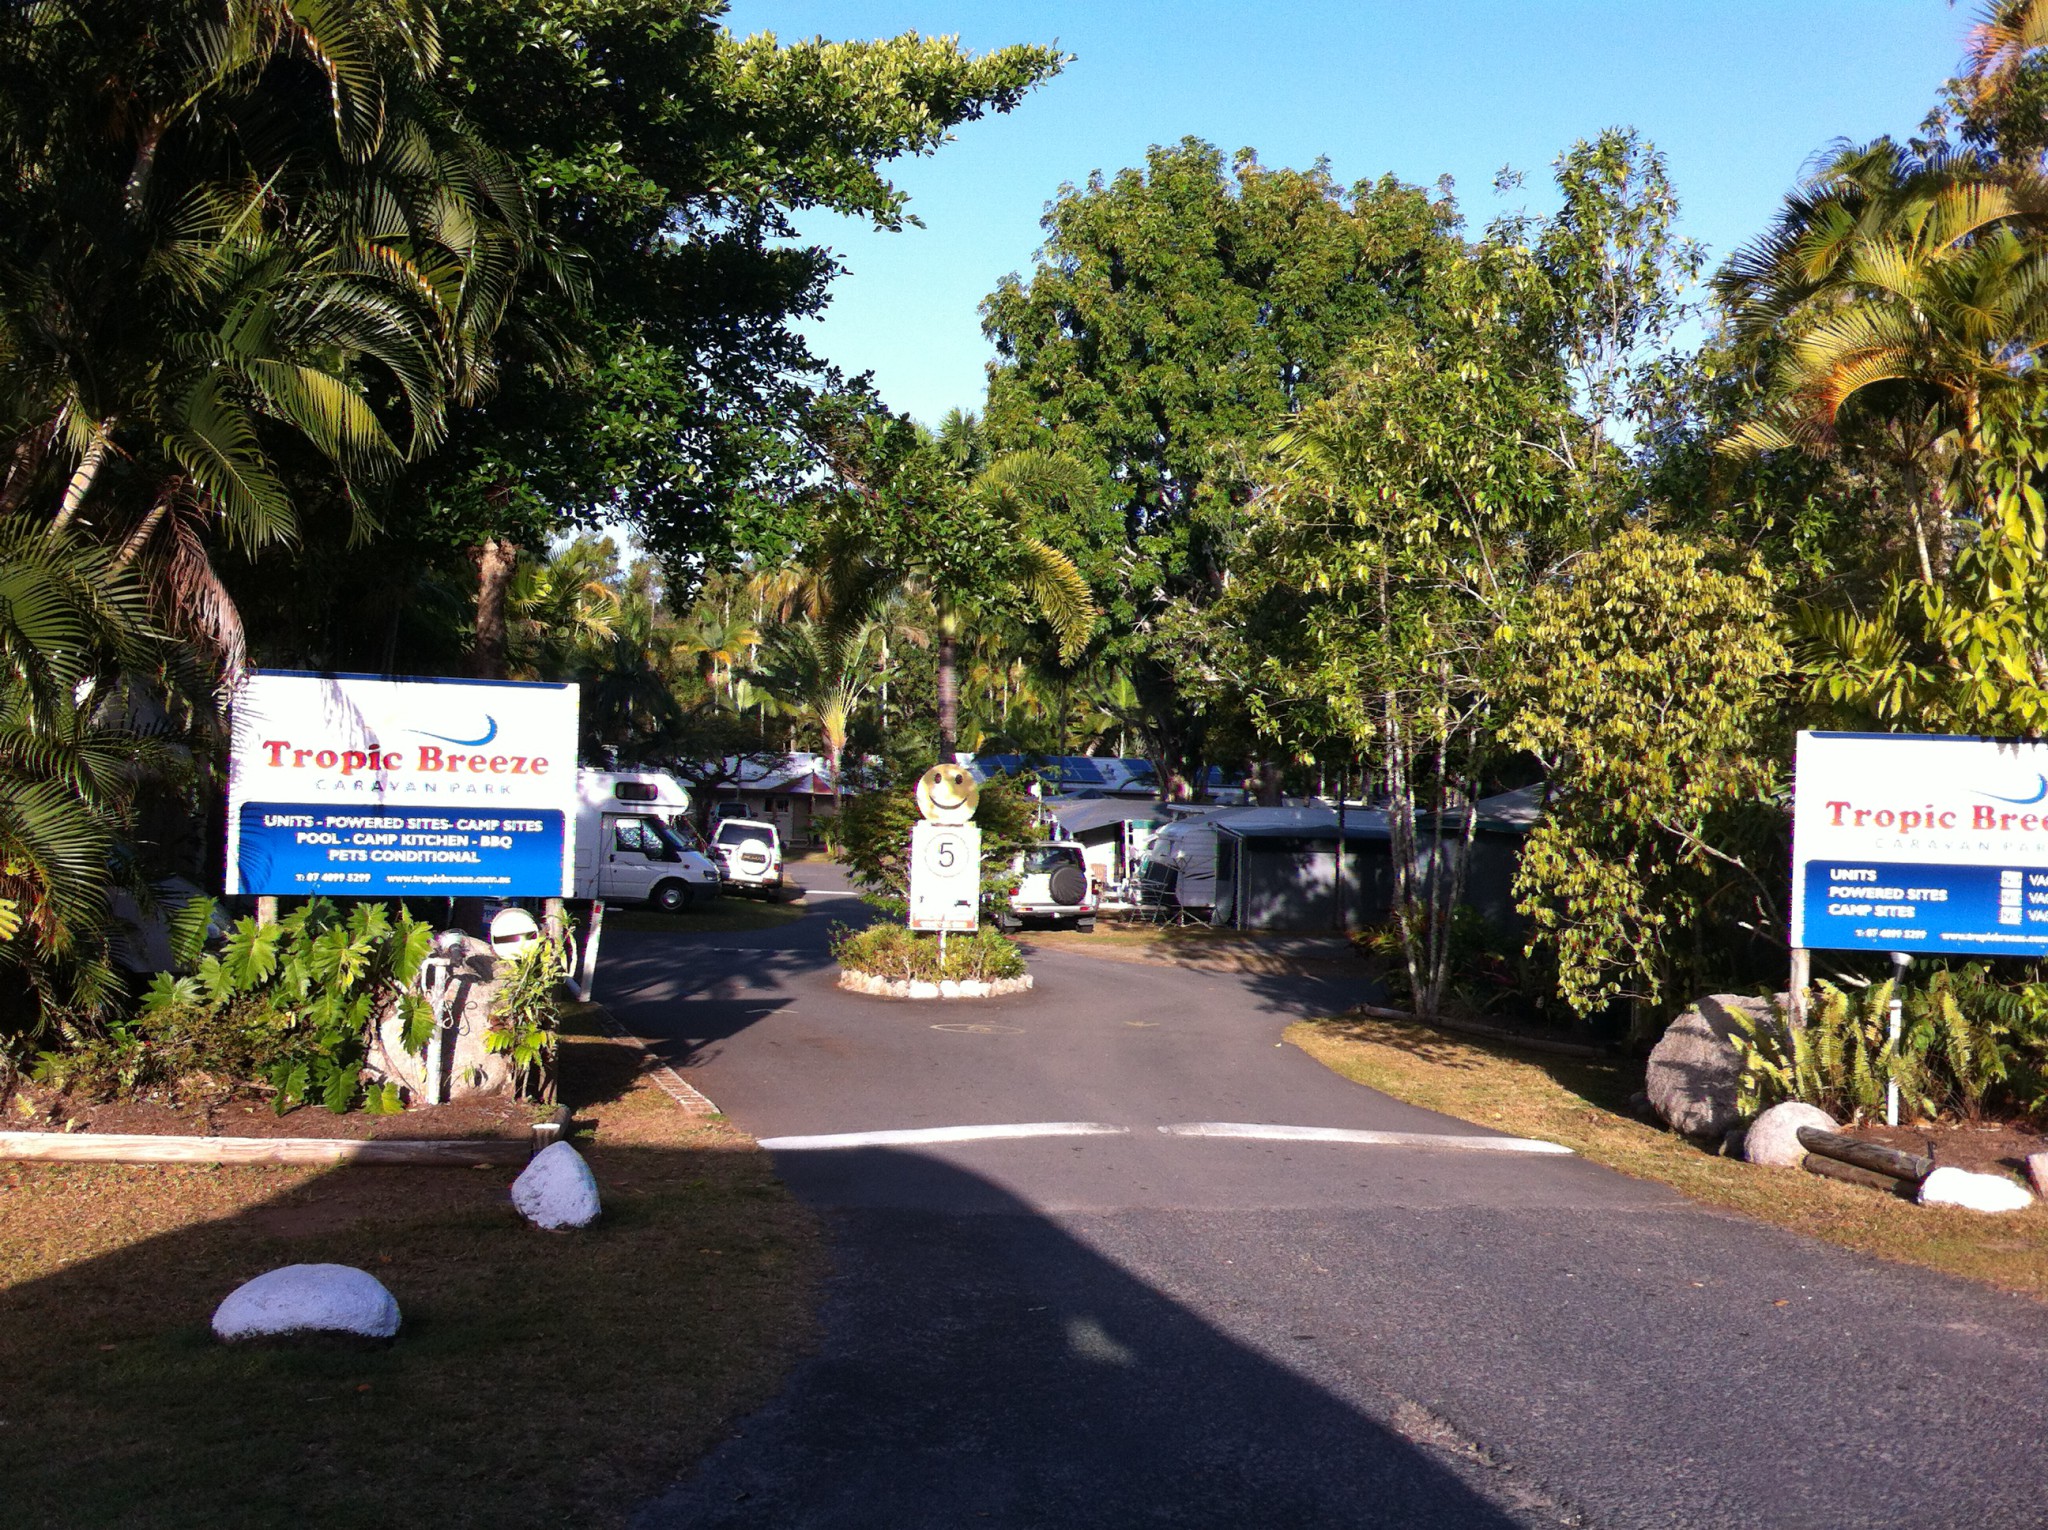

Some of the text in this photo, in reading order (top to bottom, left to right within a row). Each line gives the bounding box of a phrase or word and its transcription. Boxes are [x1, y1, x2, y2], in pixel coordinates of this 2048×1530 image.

[263, 740, 549, 775] Tropic Breeze
[316, 779, 511, 794] CARAVAN PARK
[264, 814, 314, 828] UNITS
[326, 816, 404, 830] POWERED
[457, 819, 500, 831] CAMP
[503, 820, 543, 832] SITES
[1826, 801, 1956, 834] Tropic
[297, 832, 341, 844] POOL
[353, 833, 398, 845] CAMP
[401, 834, 469, 846] KITCHEN
[480, 835, 513, 849] BBQ
[1875, 838, 1989, 851] CARAVAN
[329, 849, 481, 863] PETS CONDITIONAL
[938, 842, 955, 868] 5
[1830, 868, 1877, 882] UNITS
[1829, 886, 1948, 901] POWERED SITES
[1828, 903, 1915, 918] CAMP SITES
